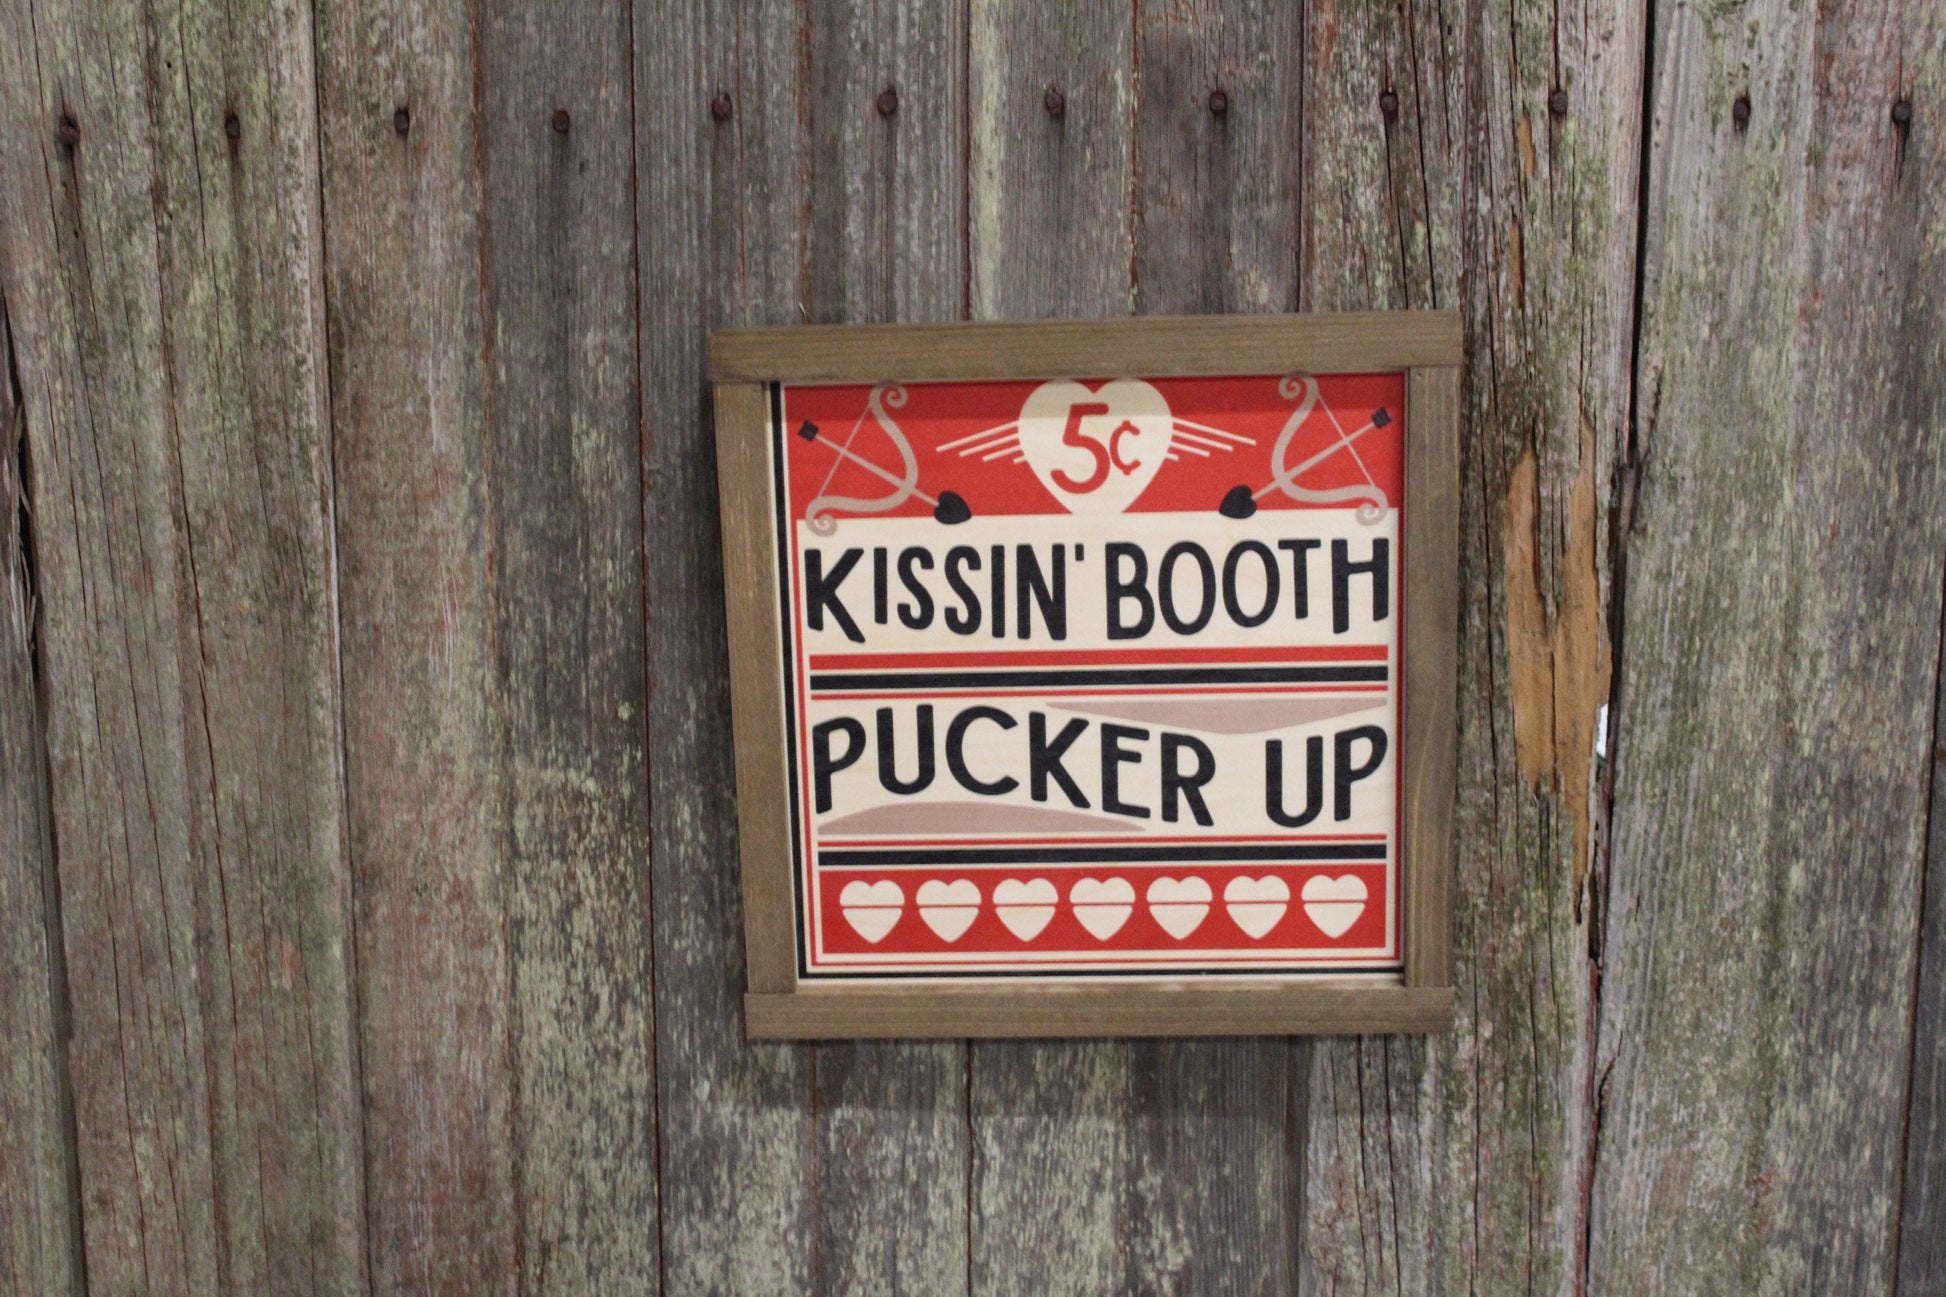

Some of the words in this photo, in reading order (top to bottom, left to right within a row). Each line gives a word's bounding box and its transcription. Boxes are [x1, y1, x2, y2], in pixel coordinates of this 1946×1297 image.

[804, 543, 1085, 643] KISSIN'
[1105, 538, 1389, 641] BOOTH
[812, 704, 1216, 827] PUCKER
[1265, 725, 1389, 828] UP
